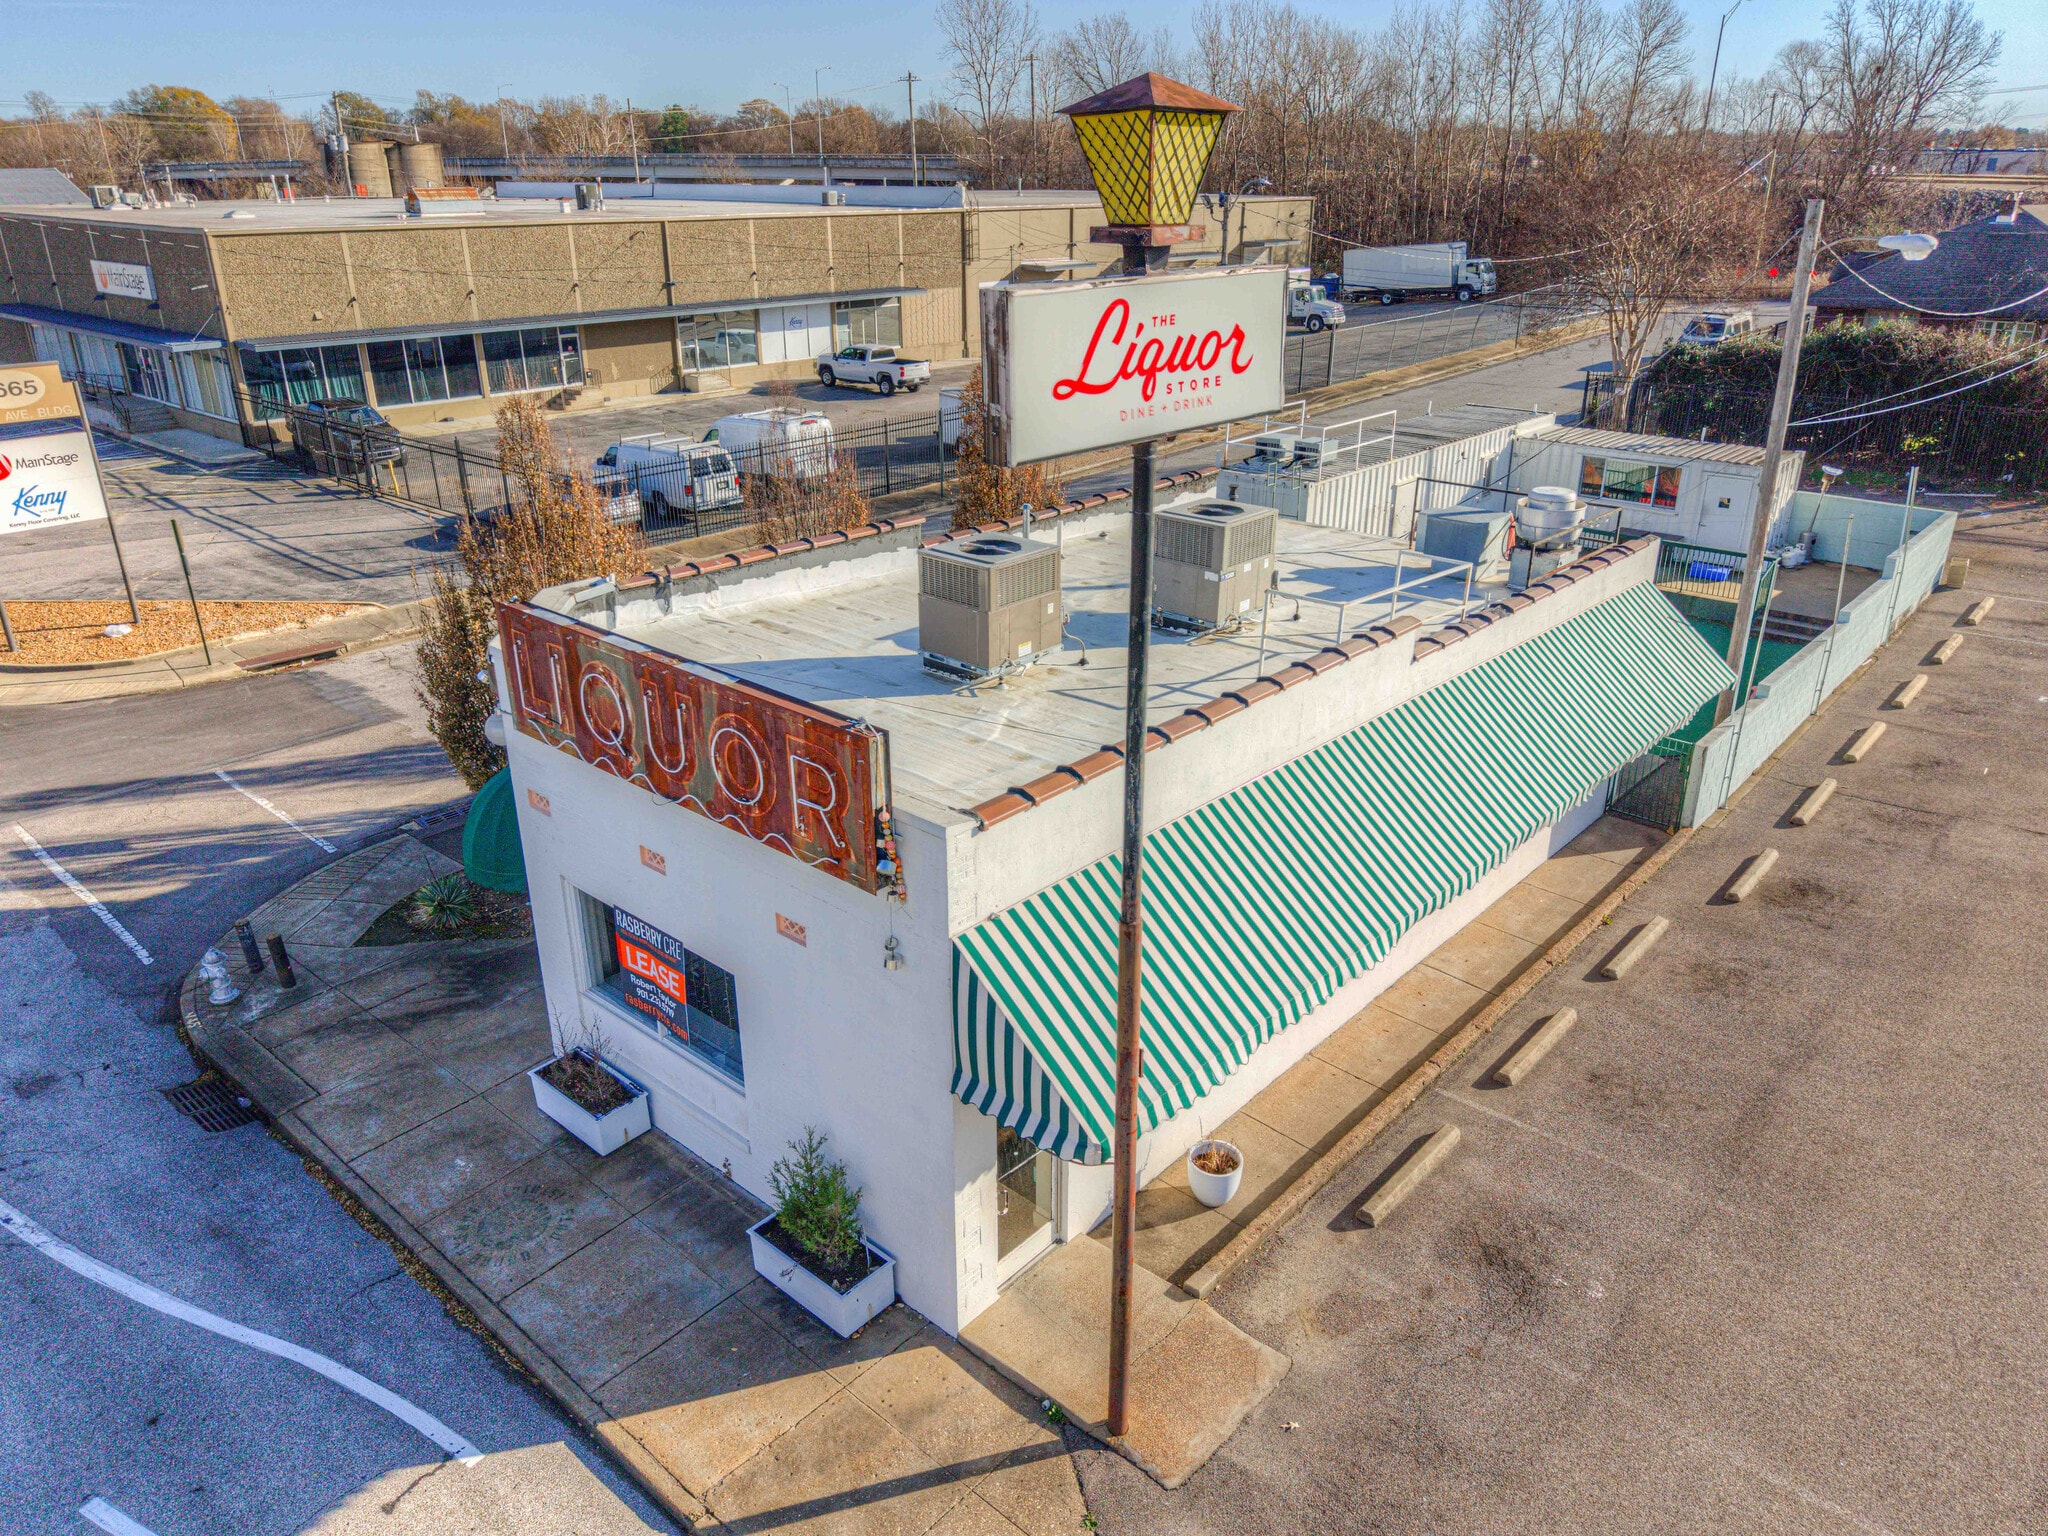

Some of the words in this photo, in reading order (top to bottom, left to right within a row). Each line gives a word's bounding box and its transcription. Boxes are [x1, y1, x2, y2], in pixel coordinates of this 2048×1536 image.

[107, 267, 145, 294] MainStage
[1152, 314, 1176, 328] THE
[1051, 298, 1254, 402] Liquor
[1166, 375, 1222, 394] STORE
[5, 409, 33, 421] AVE.
[37, 404, 76, 418] BLDG.
[1119, 405, 1155, 422] DINE
[1173, 396, 1213, 413] DRINK
[16, 453, 79, 470] MainStage
[12, 484, 67, 517] Kenny
[70, 512, 81, 520] LLC
[511, 629, 856, 862] LIQUOR
[615, 909, 662, 949] RASBERRY
[663, 936, 682, 960] CRE
[625, 945, 681, 998] LEASE
